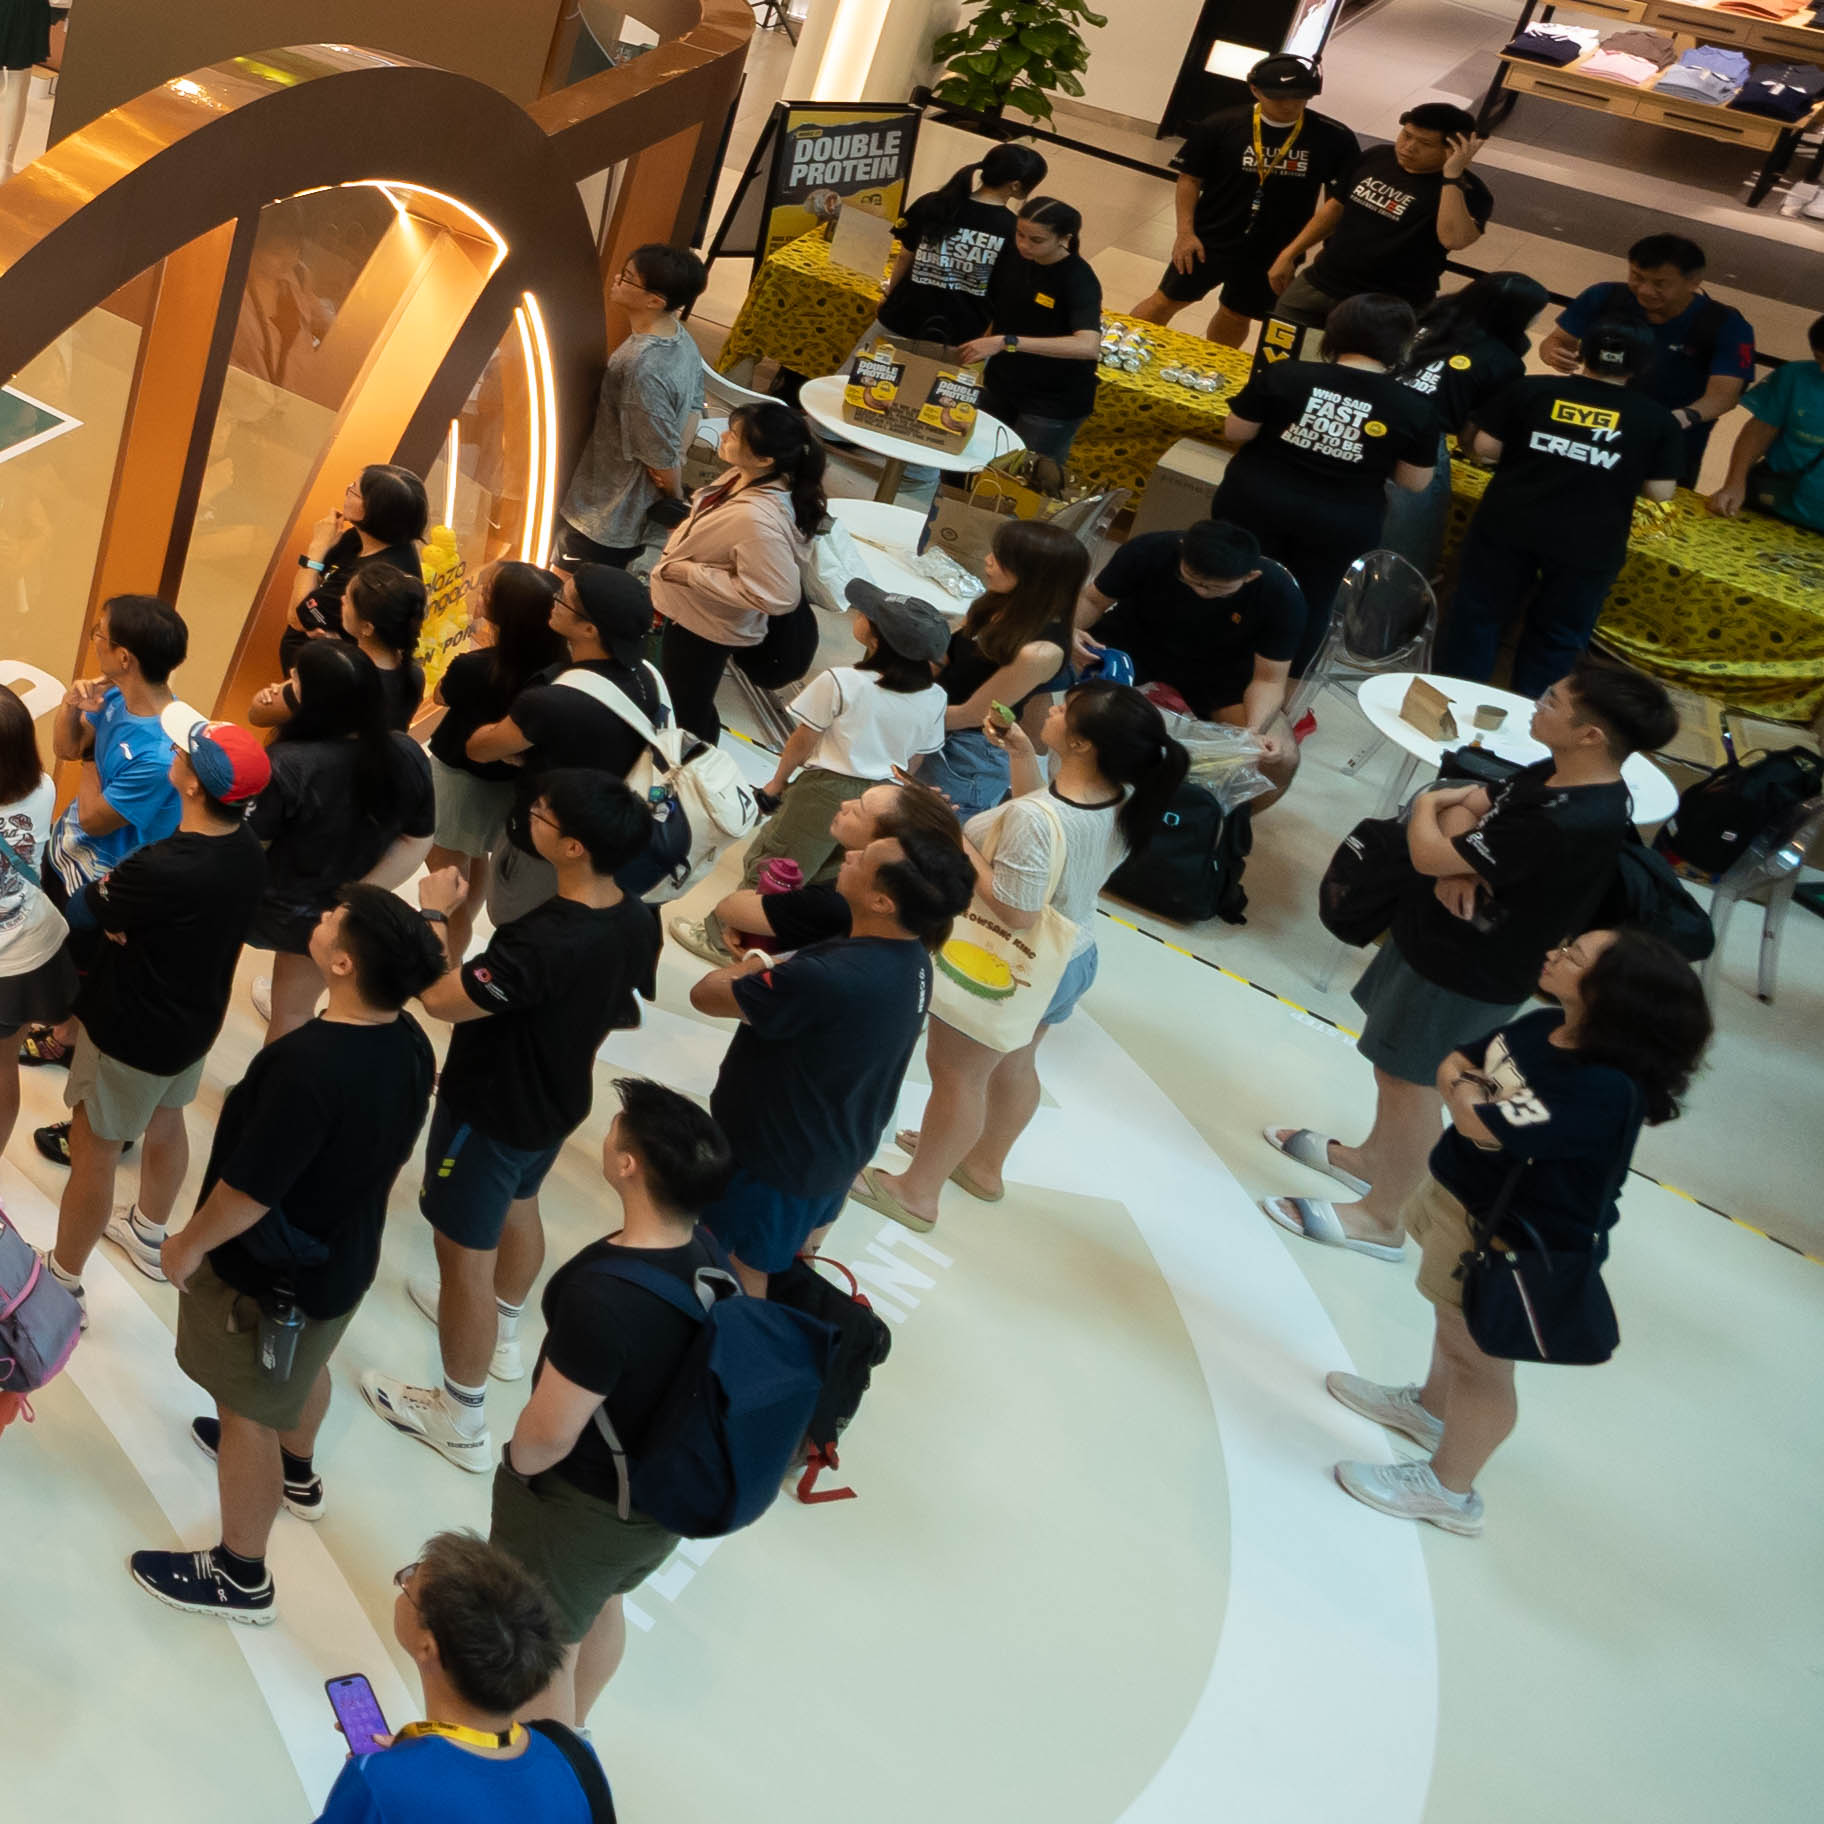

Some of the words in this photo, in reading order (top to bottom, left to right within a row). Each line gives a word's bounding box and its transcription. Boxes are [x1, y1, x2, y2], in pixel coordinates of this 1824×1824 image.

[793, 131, 902, 164] DOUBLE
[1243, 145, 1310, 163] ACUUE
[789, 155, 900, 188] PROTEIN
[1353, 185, 1408, 216] RALLIES
[1360, 176, 1416, 206] ACUVUE
[914, 249, 974, 273] BURRITO
[856, 367, 898, 382] PROTEIN
[858, 359, 899, 375] DOUBLE
[935, 388, 977, 404] PROTEIN
[938, 380, 980, 397] DOUBLE
[1312, 387, 1341, 403] WHO
[1342, 393, 1373, 413] SAID
[1304, 398, 1369, 428] FAST
[1555, 404, 1614, 428] GYG
[1289, 422, 1320, 442] HAD
[1321, 433, 1341, 447] TO
[1342, 439, 1364, 455] BE
[1299, 413, 1361, 441] FOOD
[1591, 428, 1623, 442] TV
[1281, 429, 1311, 452] BAD
[1312, 441, 1364, 464] FOOD?
[1529, 431, 1622, 470] CREW
[1012, 938, 1037, 960] KING
